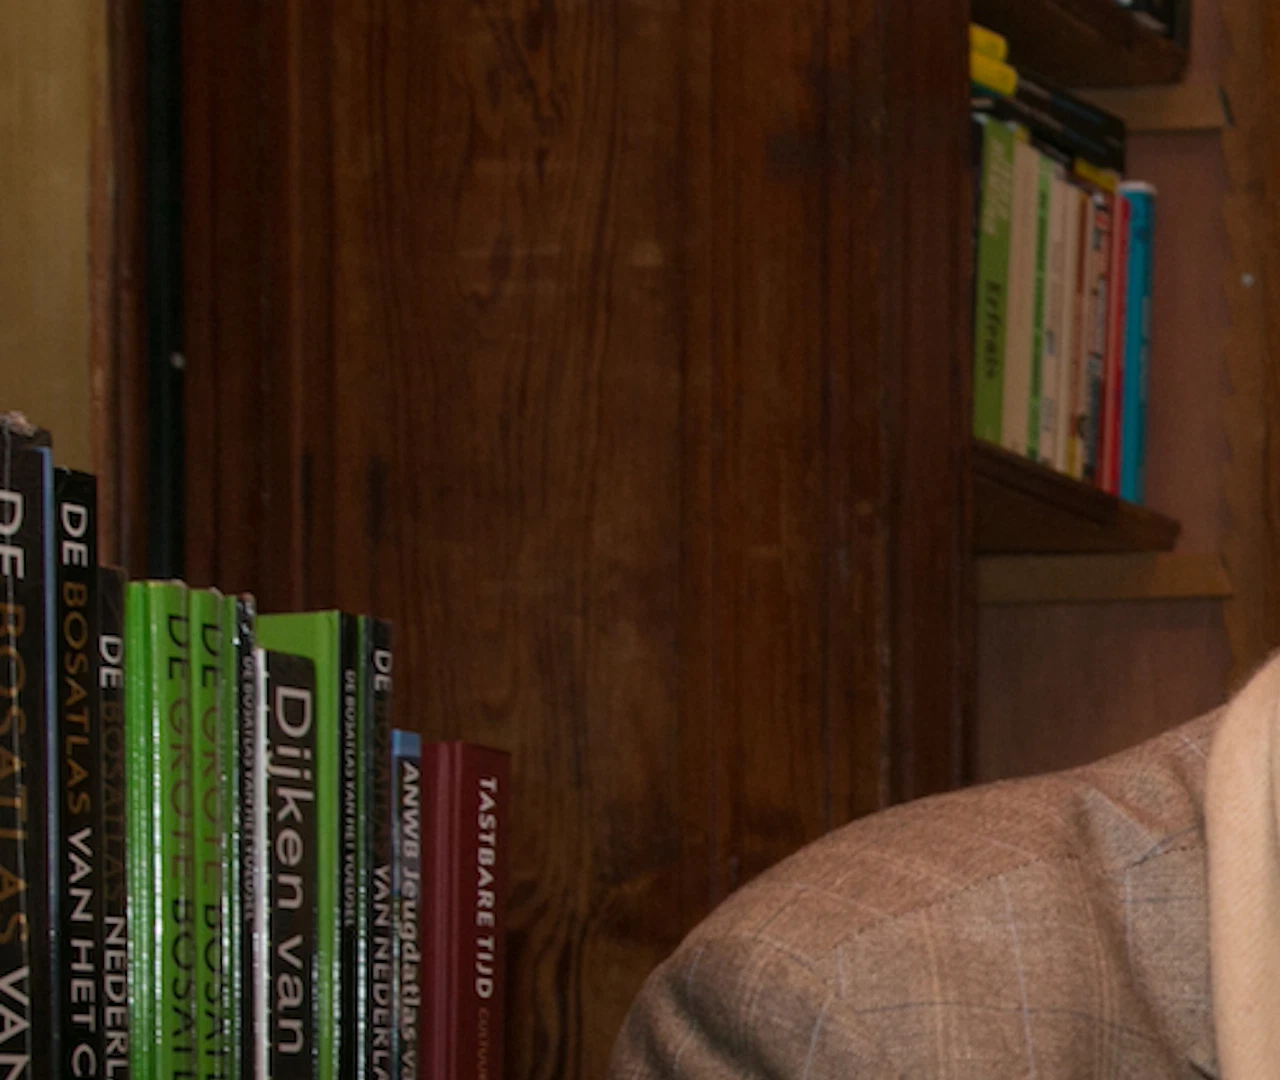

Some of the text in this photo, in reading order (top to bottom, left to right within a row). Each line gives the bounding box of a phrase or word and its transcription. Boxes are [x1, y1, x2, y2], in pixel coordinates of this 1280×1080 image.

[0, 488, 25, 581] DE
[61, 502, 89, 569] DE
[99, 634, 124, 690] DE
[168, 614, 192, 682] DE
[202, 623, 222, 689] DE
[372, 647, 393, 692] DE
[62, 581, 92, 816] BOSATLAS
[0, 601, 30, 945] BOSATLAS
[101, 699, 126, 904] BOSATLAS
[170, 697, 194, 880] GROTE
[203, 705, 223, 885] GROTE
[268, 684, 314, 910] Dijken
[401, 759, 421, 859] ANWB
[67, 826, 94, 923] VAN
[372, 864, 392, 926] VAN
[474, 775, 498, 999] TASTBARE TIJD
[70, 938, 98, 1033] HET
[276, 933, 304, 1054] van
[398, 865, 421, 1040] Jeugdatlas
